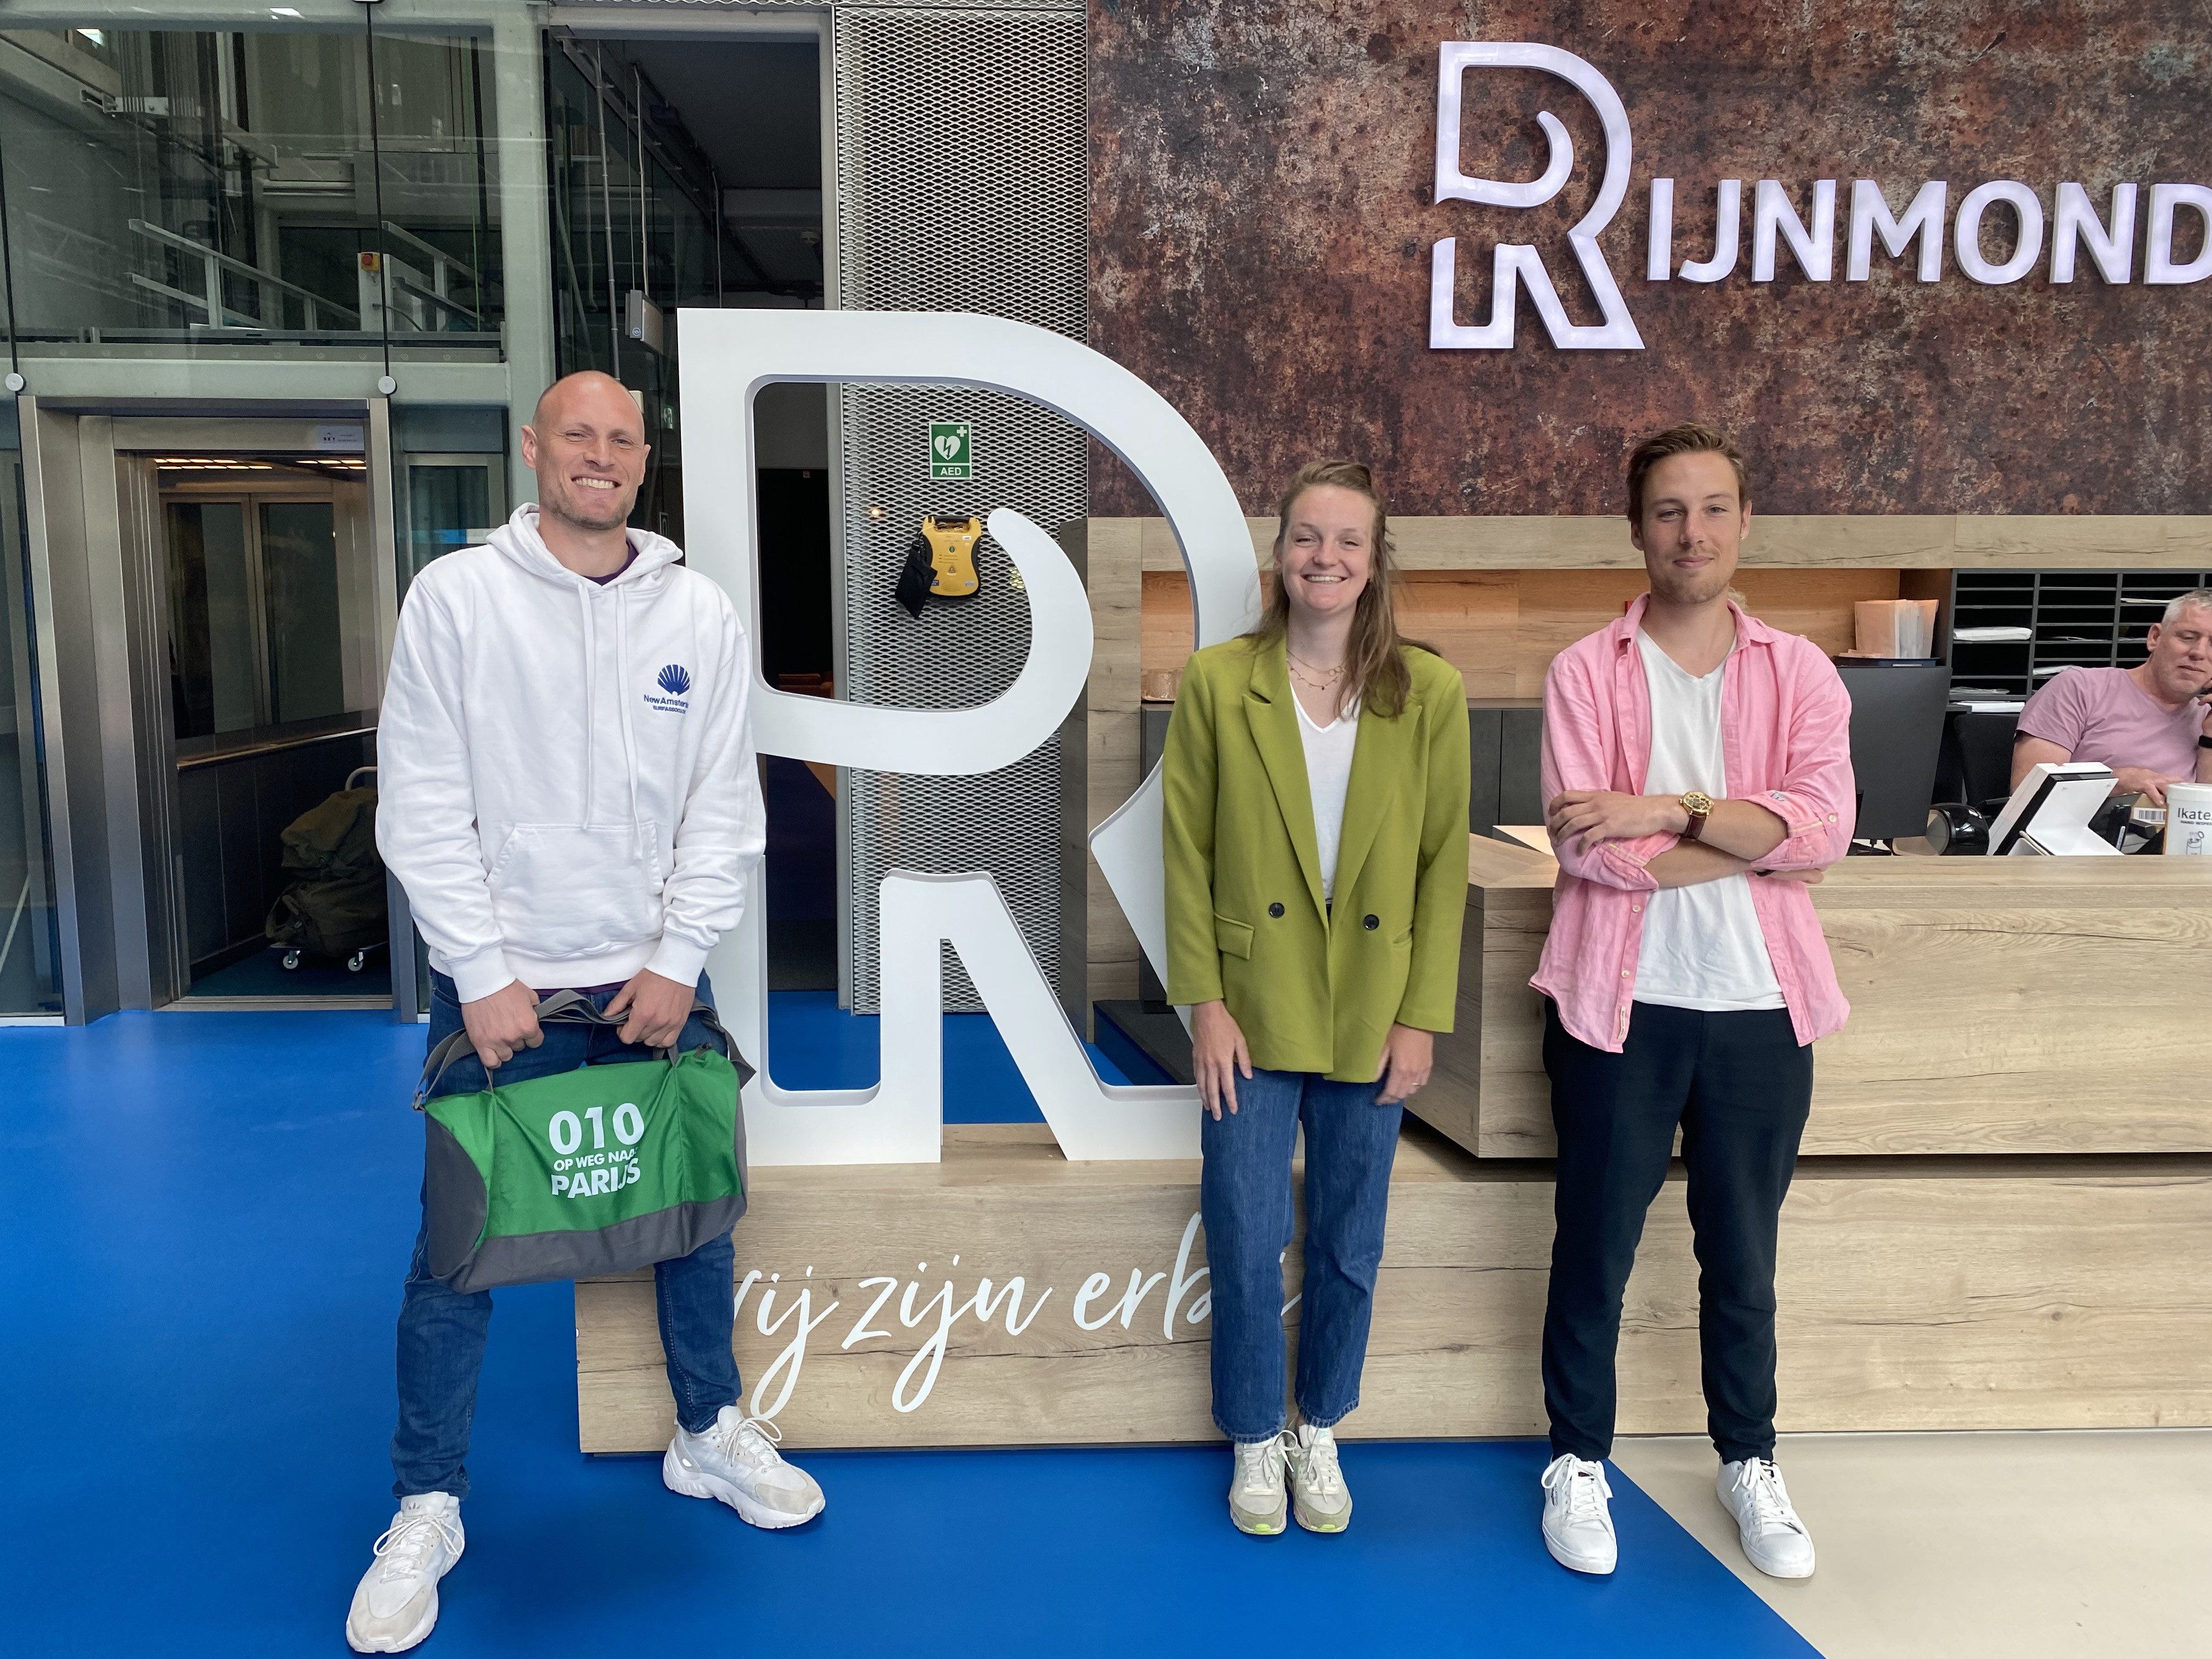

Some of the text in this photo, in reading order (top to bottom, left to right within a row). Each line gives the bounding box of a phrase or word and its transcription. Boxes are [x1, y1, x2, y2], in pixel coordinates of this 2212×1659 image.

[940, 467, 962, 476] AED
[2177, 807, 2212, 820] Ikate
[549, 1103, 645, 1155] 010
[554, 1147, 638, 1171] OP WEG NAA
[551, 1158, 641, 1199] PARIJS
[841, 1254, 1053, 1413] zijn
[1073, 1211, 1302, 1340] erb
